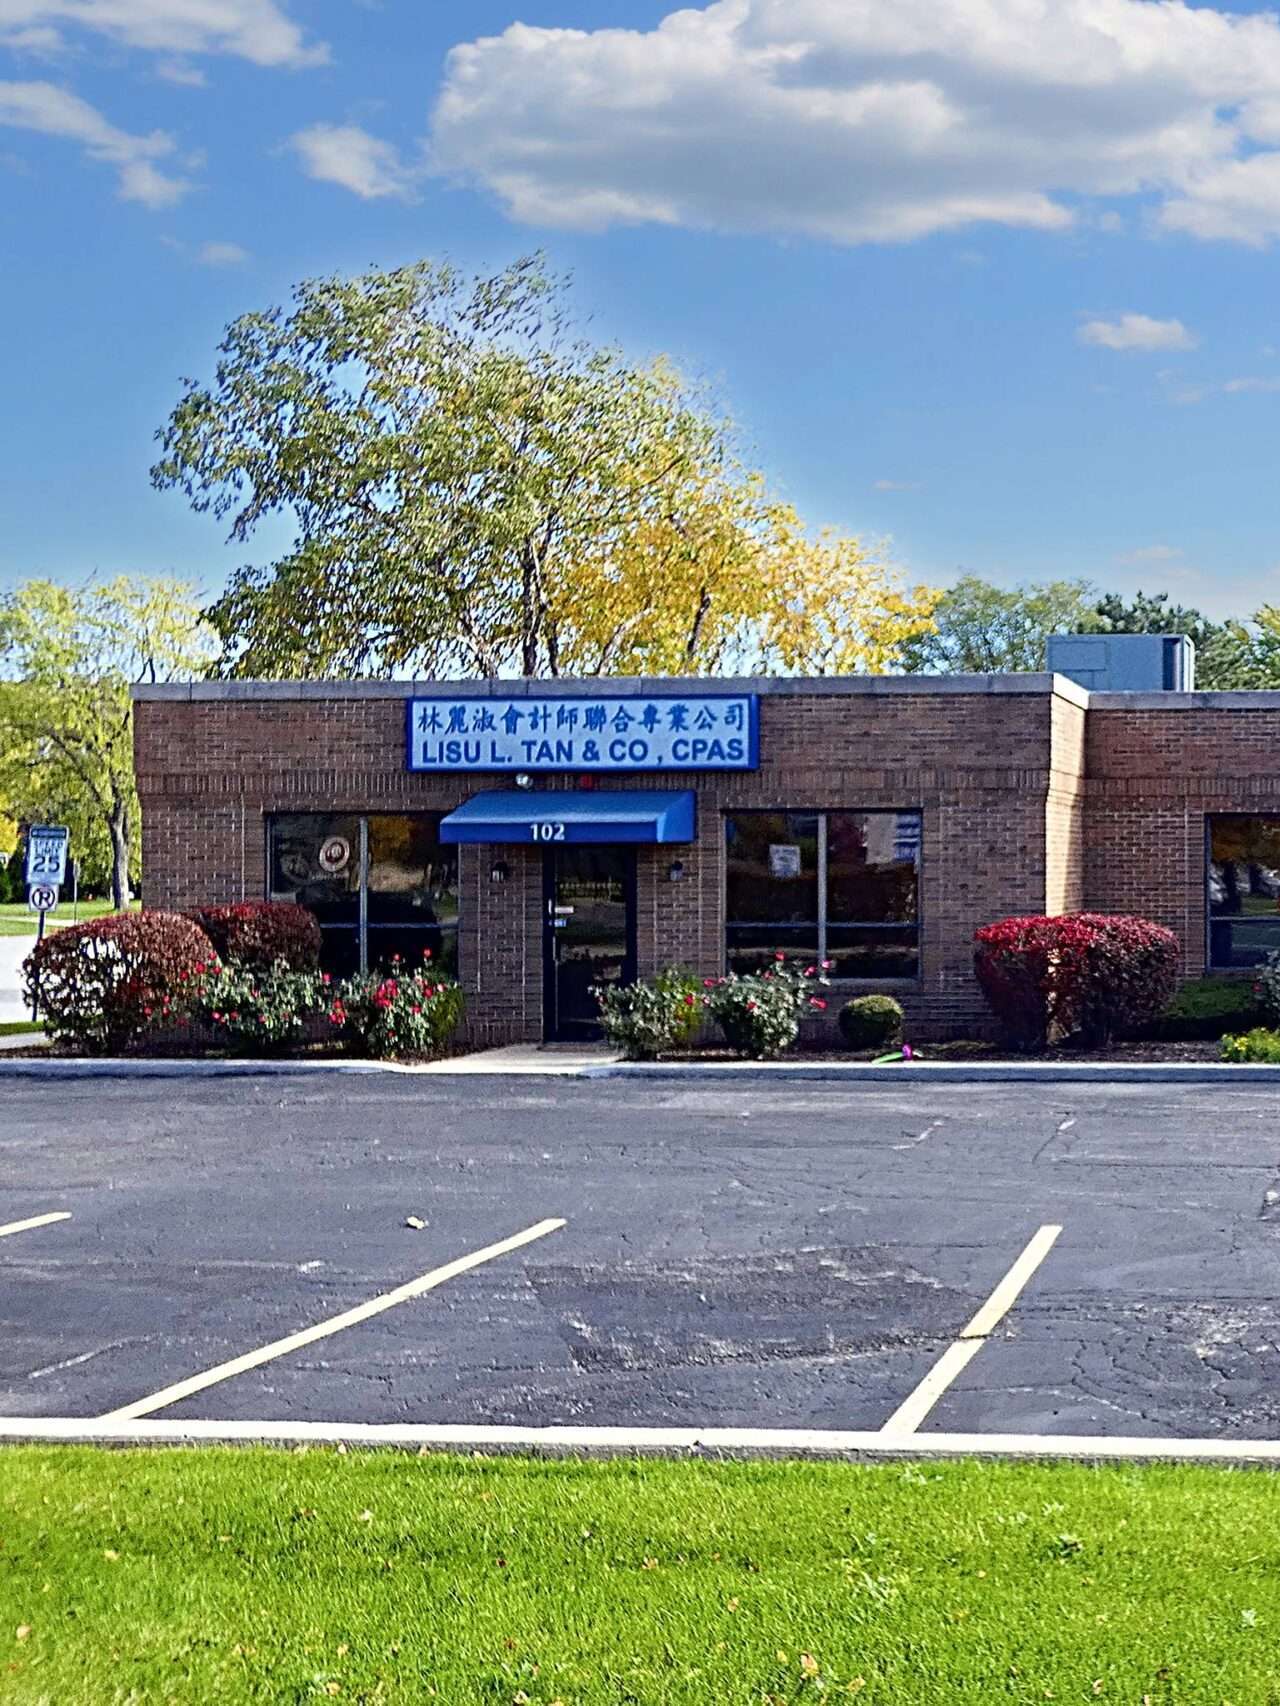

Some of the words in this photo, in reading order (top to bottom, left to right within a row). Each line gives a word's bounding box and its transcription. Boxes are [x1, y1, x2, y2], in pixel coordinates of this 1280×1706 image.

[422, 740, 481, 764] LISU
[491, 740, 512, 763] L.
[521, 740, 574, 763] TAN
[582, 739, 600, 762] &
[671, 738, 744, 762] CPAS
[530, 823, 566, 841] 102
[33, 856, 60, 873] 25
